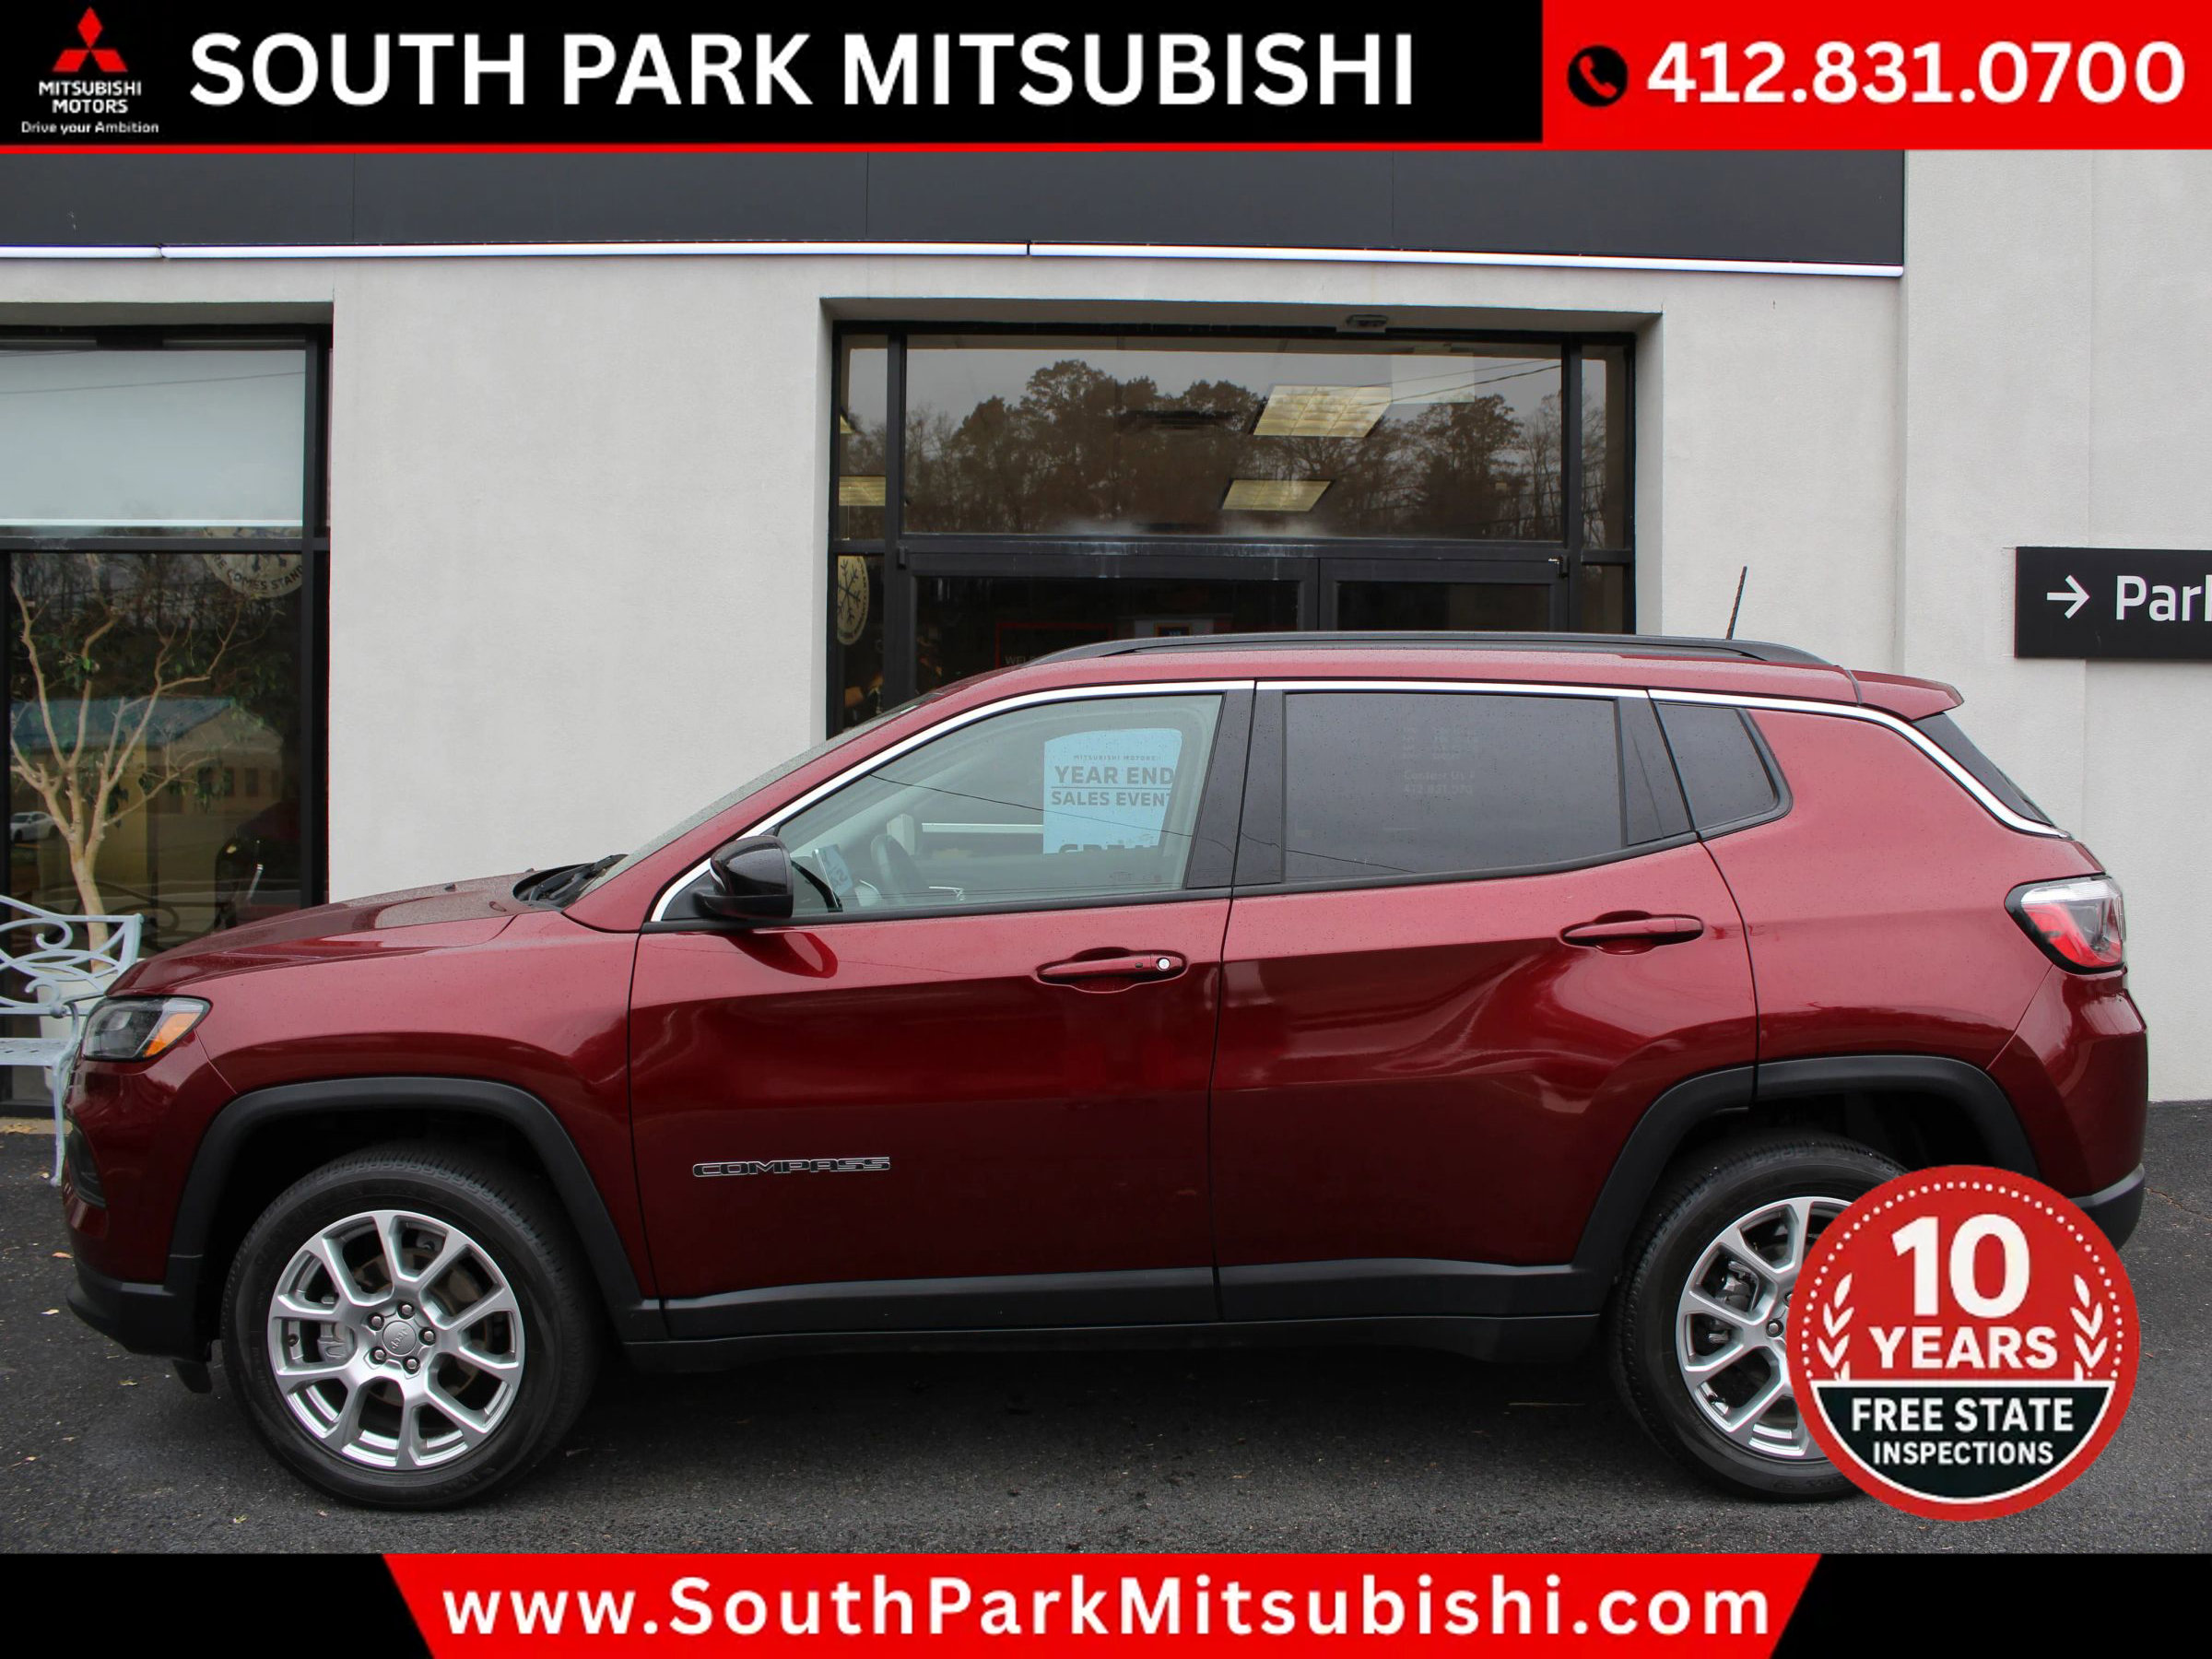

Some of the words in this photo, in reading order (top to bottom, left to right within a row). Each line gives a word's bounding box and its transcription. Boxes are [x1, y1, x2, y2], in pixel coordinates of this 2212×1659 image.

[1054, 765, 1119, 784] YEAR
[1126, 766, 1174, 785] END
[1051, 791, 1111, 806] SALES
[692, 1156, 891, 1178] COMPASS
